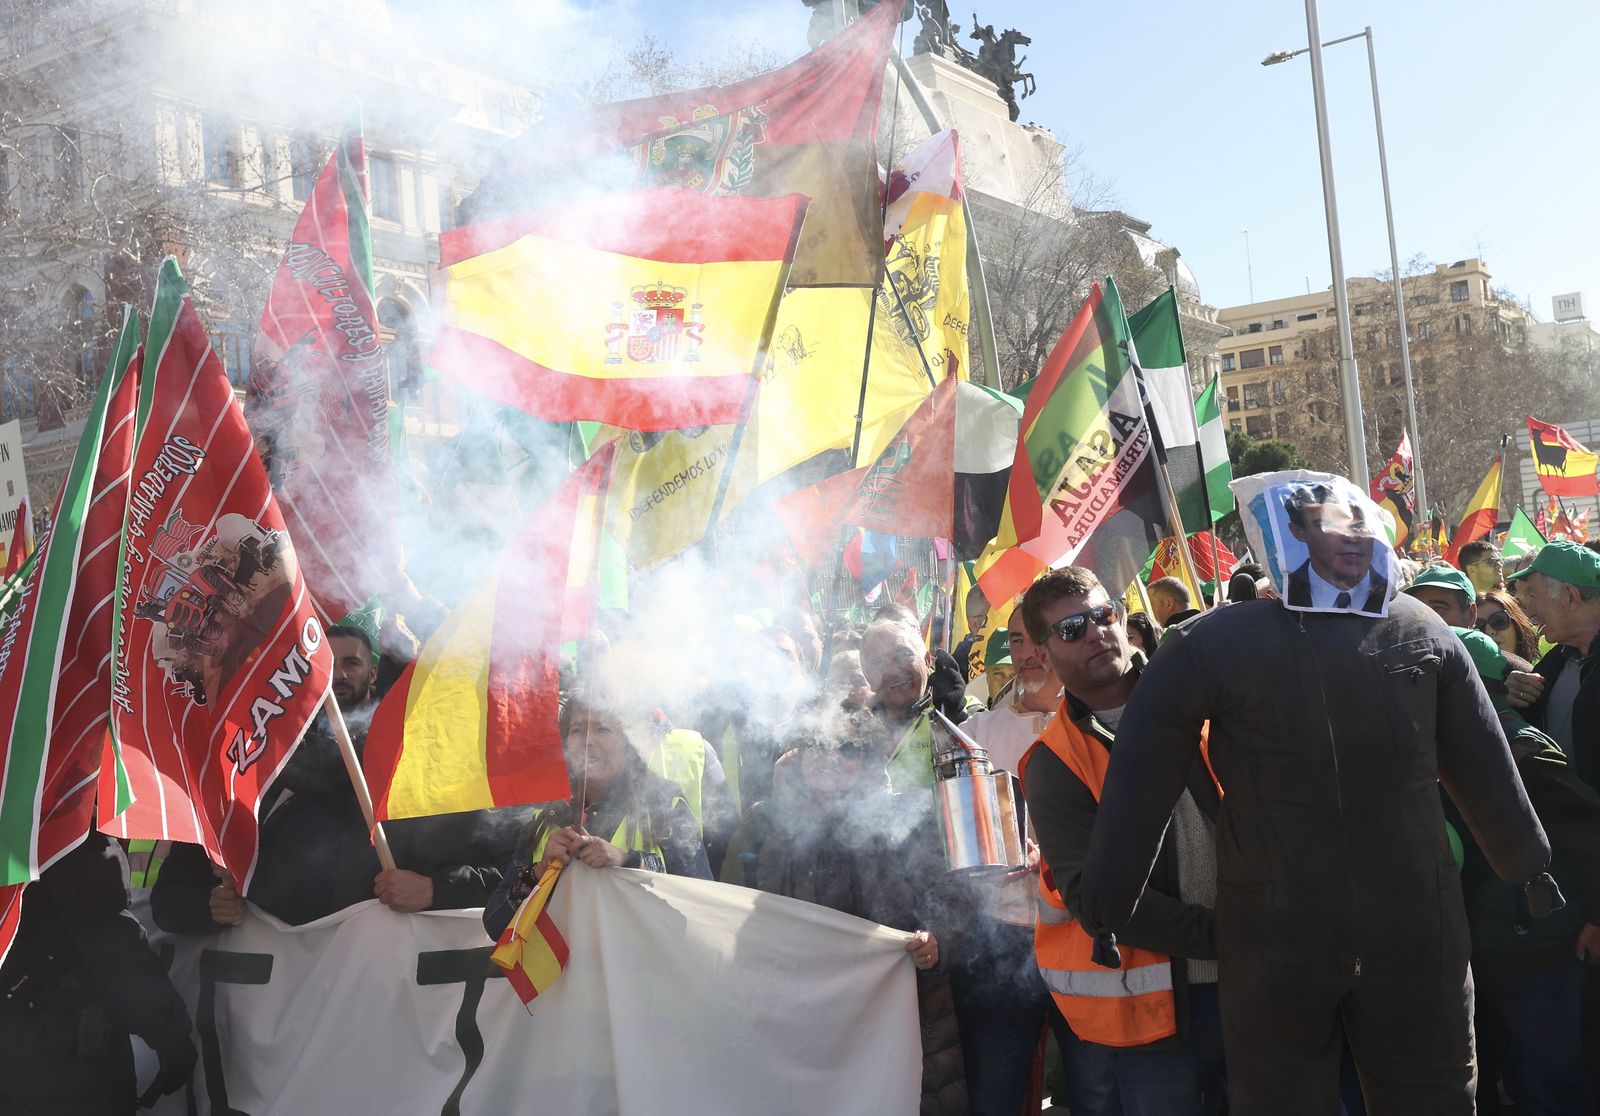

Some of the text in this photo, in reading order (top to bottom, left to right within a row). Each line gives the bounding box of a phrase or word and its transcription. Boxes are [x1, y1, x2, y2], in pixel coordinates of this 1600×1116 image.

[128, 435, 207, 538] GANADEROS
[628, 460, 704, 520] DEFENDEMOS
[226, 615, 322, 776] ZAMO
